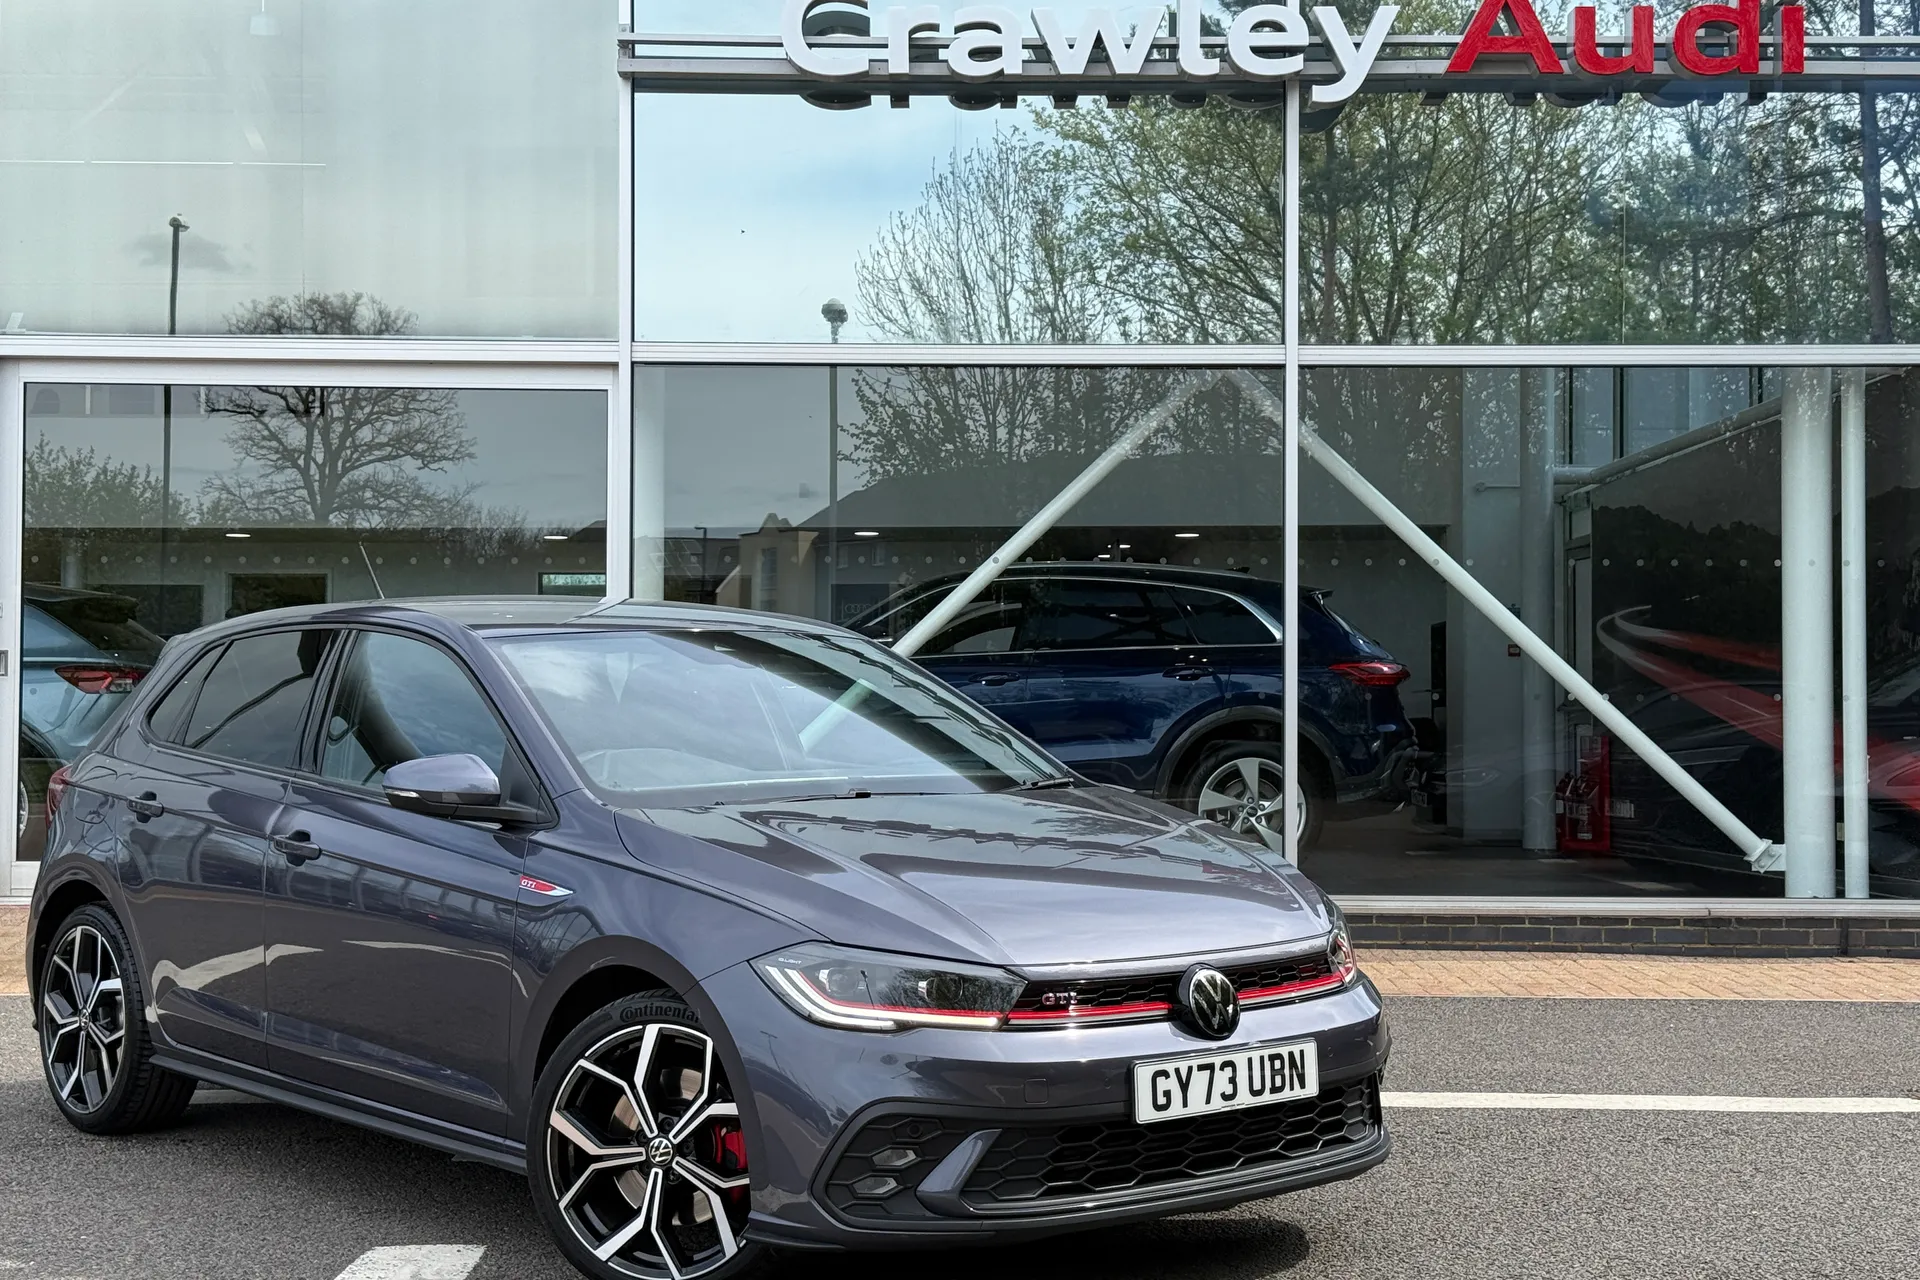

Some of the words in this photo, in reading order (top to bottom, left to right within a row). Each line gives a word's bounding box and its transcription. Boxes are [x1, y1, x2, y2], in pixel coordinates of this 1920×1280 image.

[784, 0, 1399, 103] Crawley
[1447, 0, 1804, 75] Audi
[521, 879, 537, 889] GTI
[1041, 991, 1078, 1005] GTI
[1150, 1059, 1239, 1113] GY73
[1246, 1048, 1307, 1098] UBN
